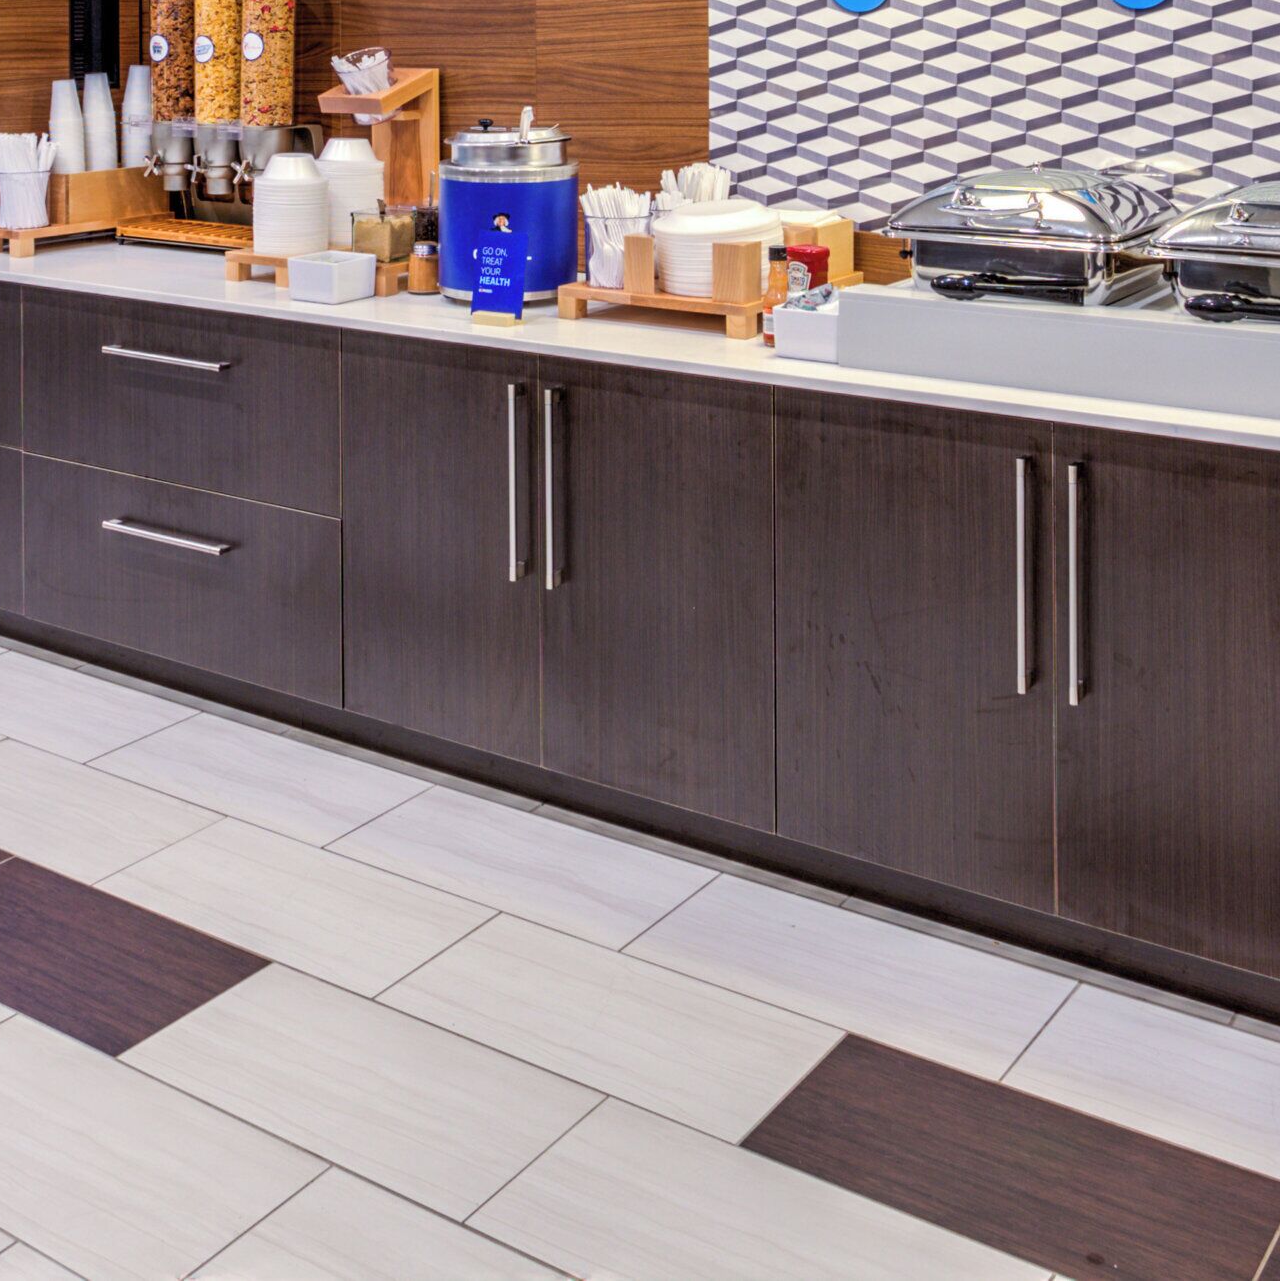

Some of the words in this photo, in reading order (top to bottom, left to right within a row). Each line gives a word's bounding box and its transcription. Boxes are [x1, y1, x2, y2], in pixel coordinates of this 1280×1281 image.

[482, 246, 494, 256] GO
[482, 256, 503, 266] TREAT
[481, 267, 501, 276] YOUR
[479, 276, 511, 287] HEALTH
